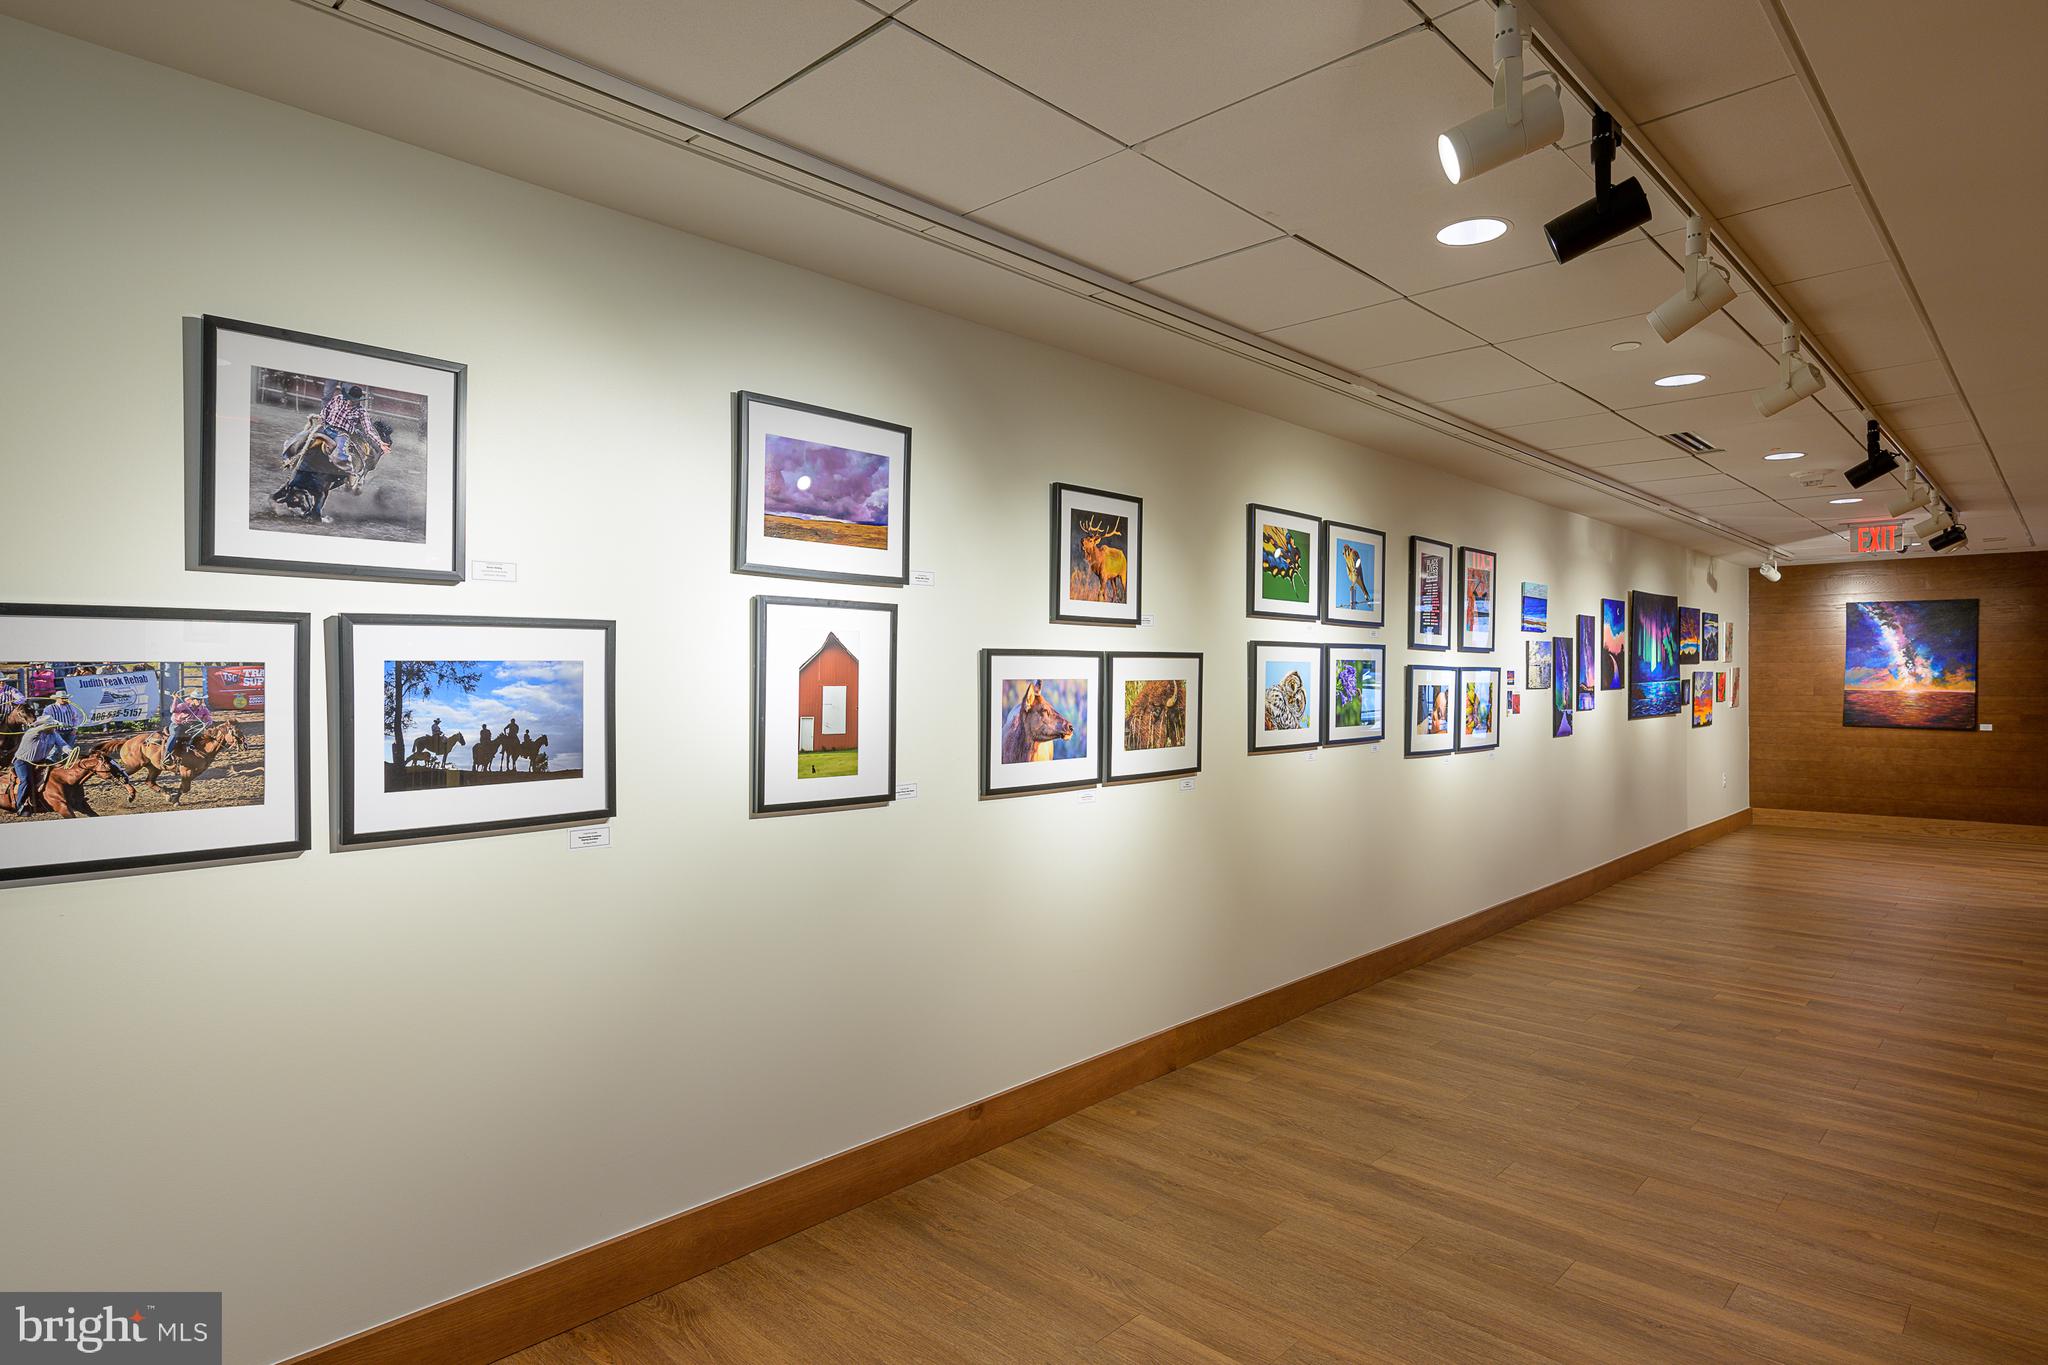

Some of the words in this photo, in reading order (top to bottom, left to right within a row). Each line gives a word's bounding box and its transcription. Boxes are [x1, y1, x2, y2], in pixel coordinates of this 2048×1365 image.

[1857, 525, 1898, 552] EXIT
[80, 679, 104, 688] Judith
[123, 675, 148, 685] Rehab
[223, 672, 238, 682] TSC
